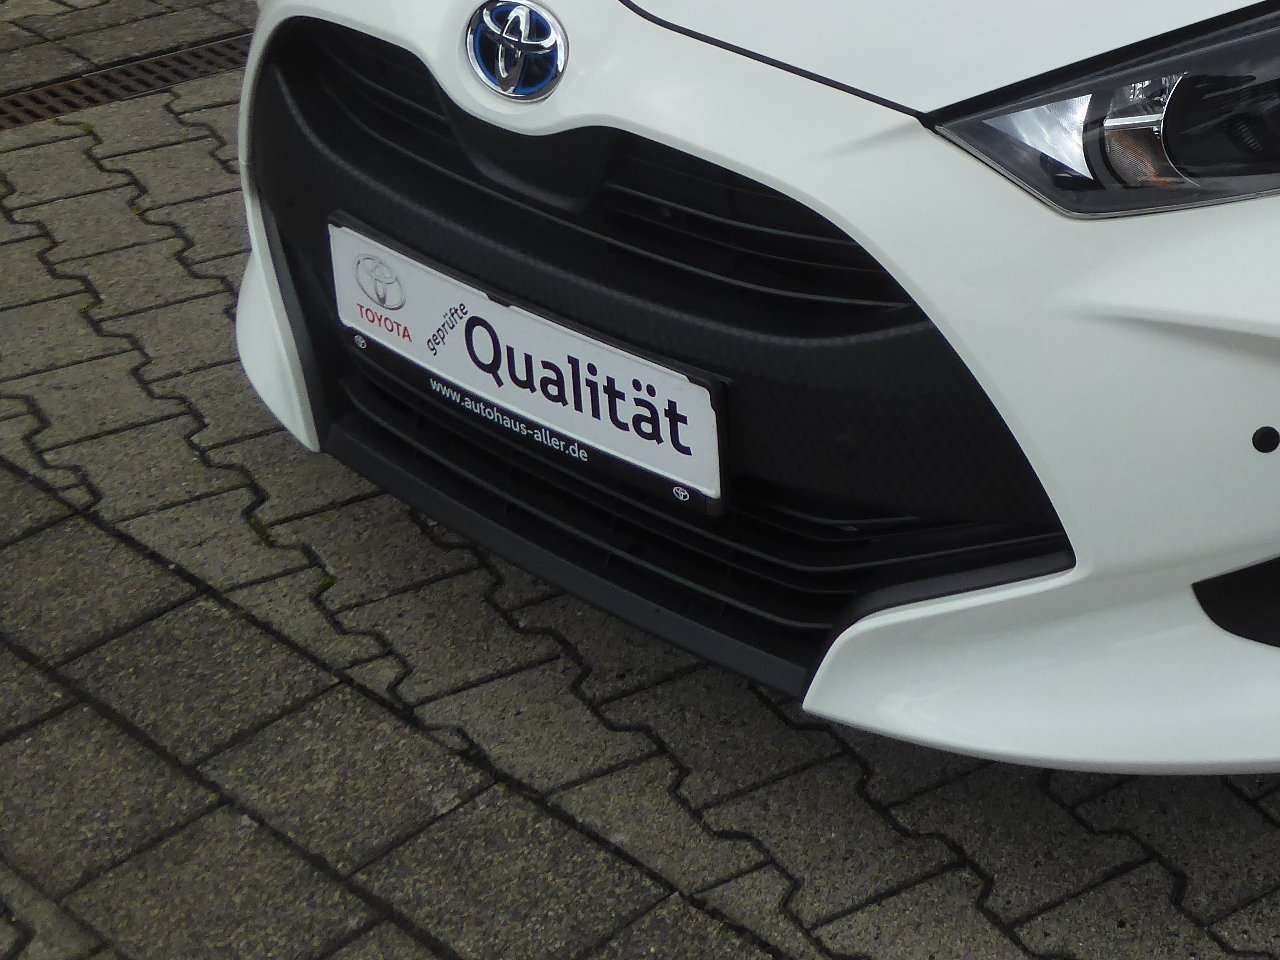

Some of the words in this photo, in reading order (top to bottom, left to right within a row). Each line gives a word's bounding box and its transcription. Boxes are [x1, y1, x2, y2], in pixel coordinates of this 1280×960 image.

[356, 302, 413, 343] TOYOTA
[426, 301, 469, 356] geprüfte
[429, 377, 589, 462] www.autohaus-aller.de
[464, 315, 693, 456] Qualität
